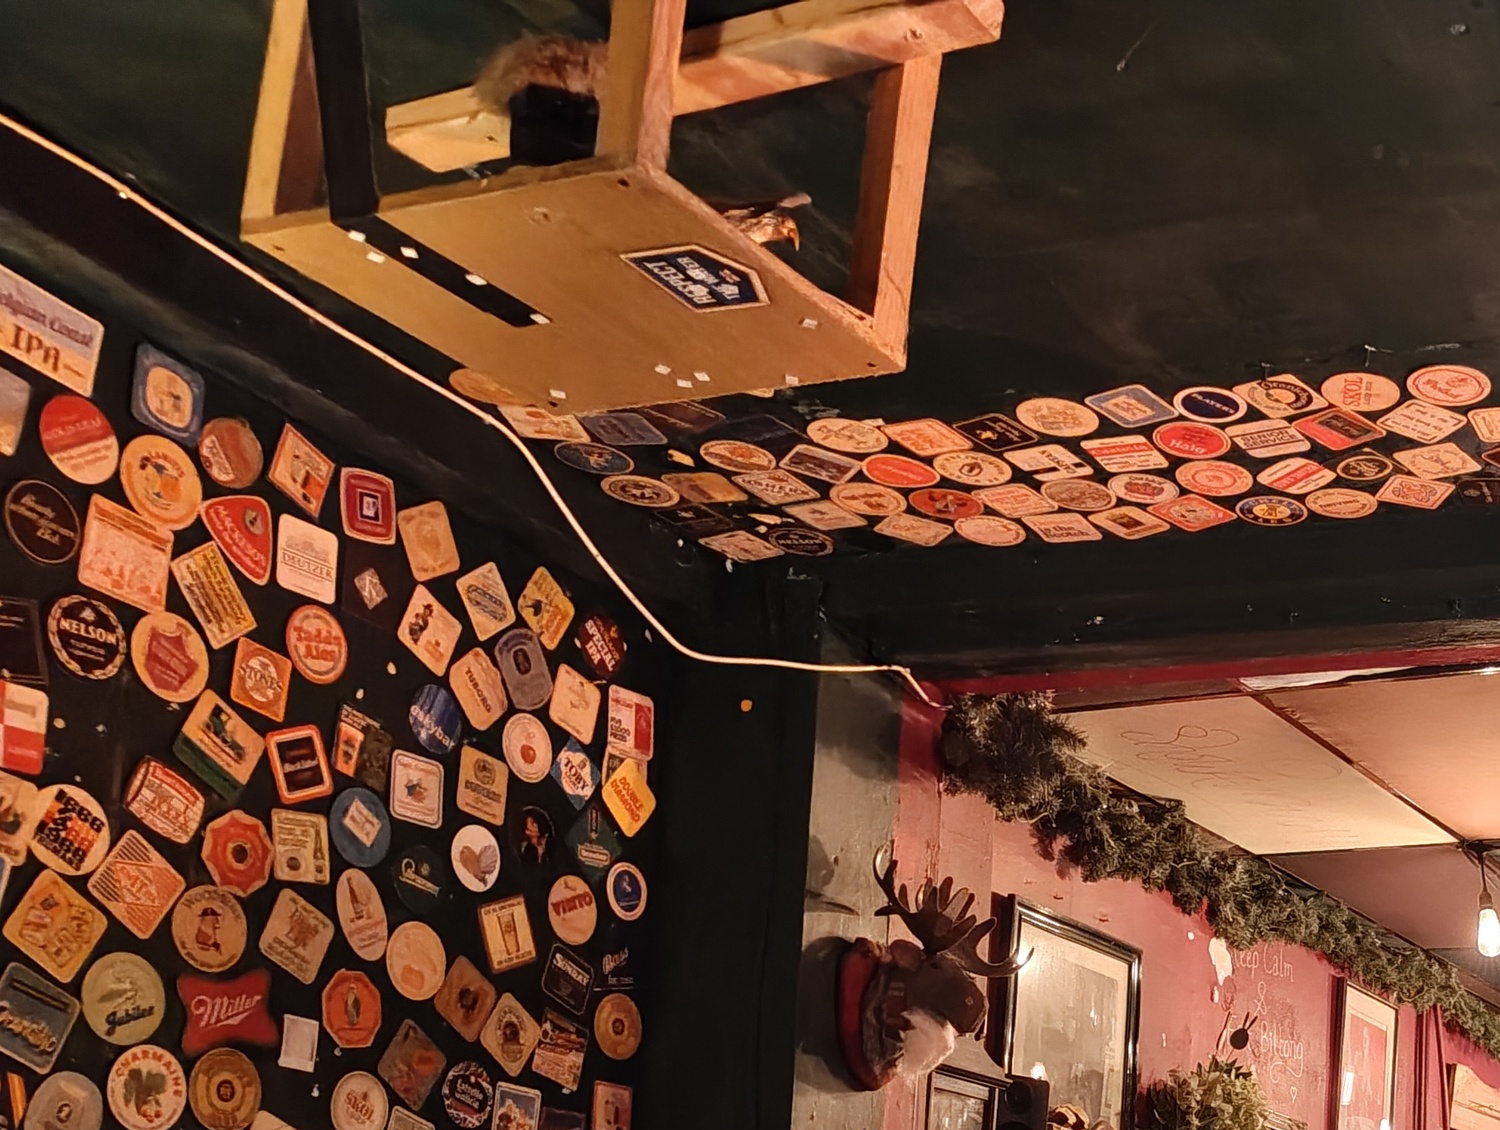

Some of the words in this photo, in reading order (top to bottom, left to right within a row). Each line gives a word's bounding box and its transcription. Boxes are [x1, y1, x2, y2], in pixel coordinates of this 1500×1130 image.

[11, 322, 60, 373] IPA
[1342, 376, 1364, 407] SKOL
[1169, 438, 1206, 454] Haig
[1240, 429, 1291, 442] SENIOR
[1243, 433, 1299, 448] SERVICE
[60, 617, 117, 646] NELSON
[585, 619, 615, 672] SPECIAL
[585, 640, 601, 665] IPA
[465, 665, 493, 715] TUBORG
[563, 756, 589, 791] TOBY
[610, 779, 641, 822] DIAMOND
[618, 776, 644, 810] DOUBLE
[551, 891, 593, 917] VIMTO
[553, 952, 590, 986] SUNRAY
[1263, 944, 1295, 982] Calm
[191, 993, 262, 1029] Miller
[1261, 1020, 1304, 1078] Biltong
[115, 1047, 183, 1099] CHARMAINE
